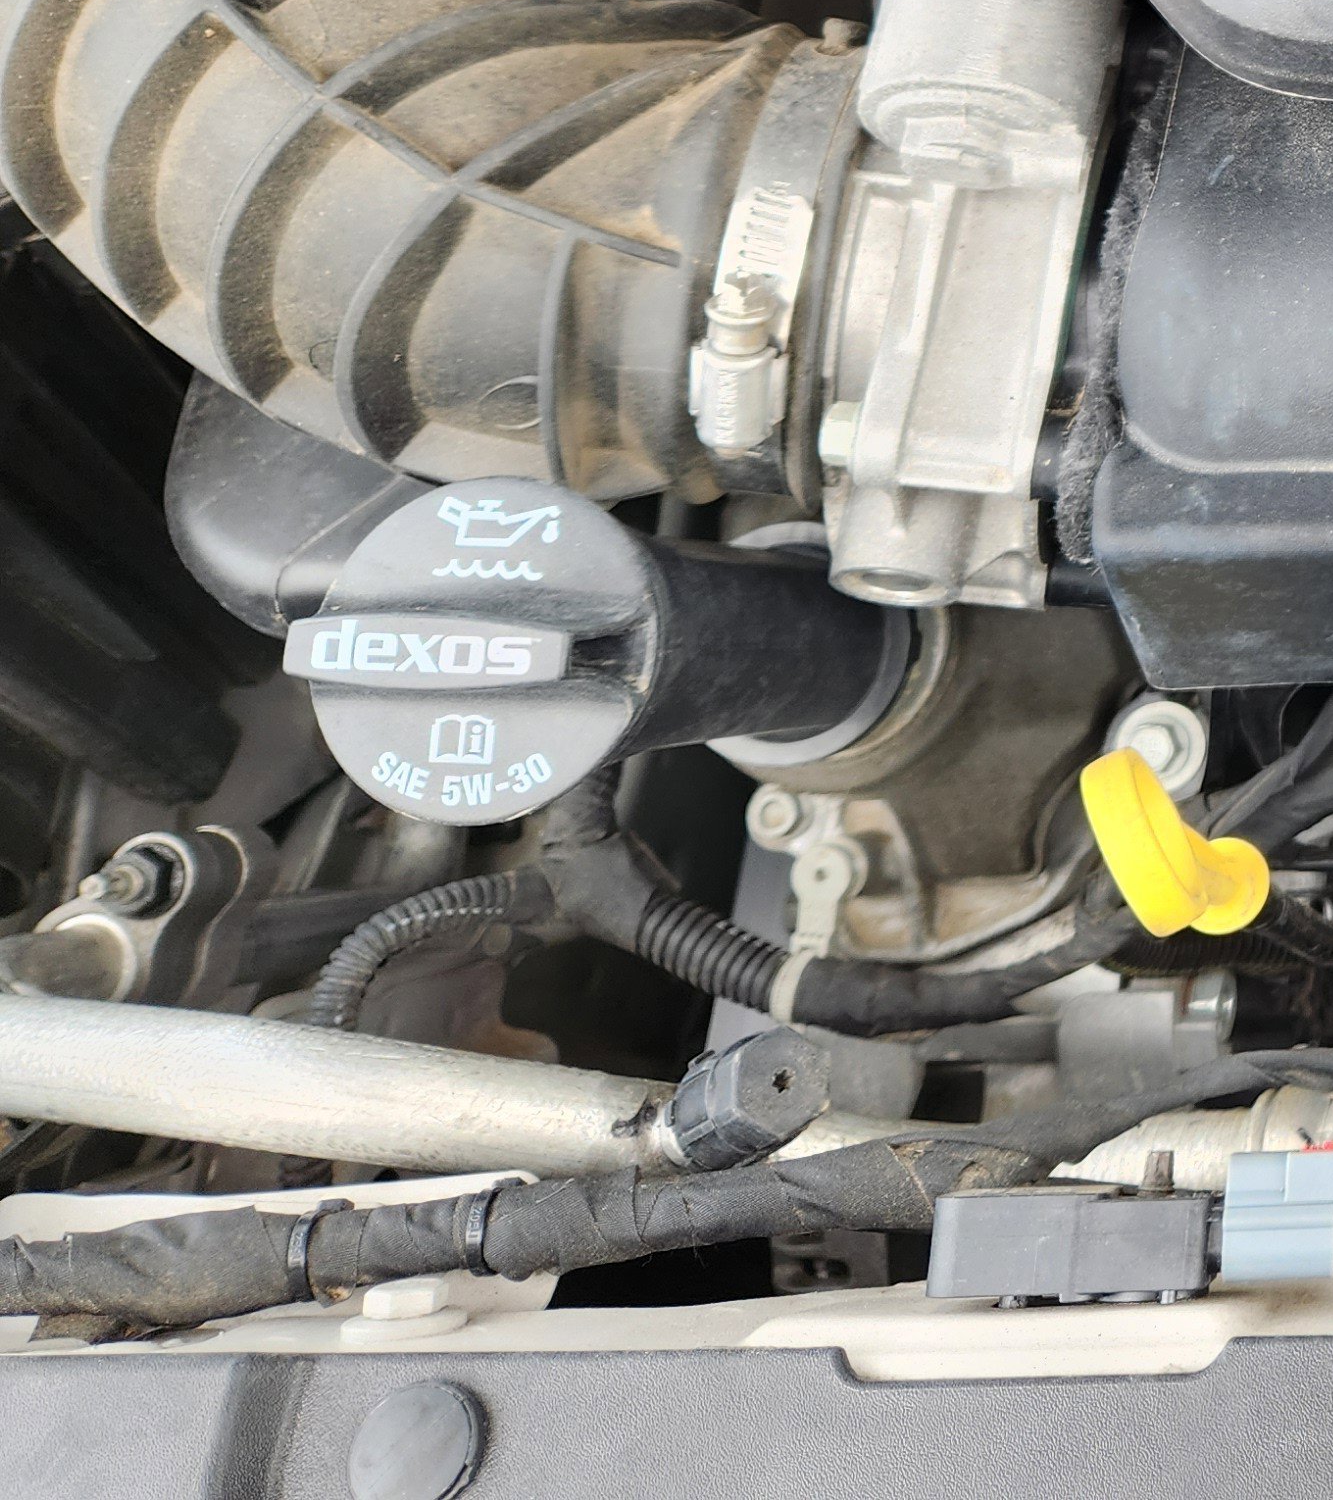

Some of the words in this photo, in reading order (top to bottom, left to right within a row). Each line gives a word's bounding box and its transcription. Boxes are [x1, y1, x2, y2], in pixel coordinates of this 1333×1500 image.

[310, 619, 534, 675] dexos
[370, 750, 430, 802] SAE
[440, 751, 552, 806] 5W-30
